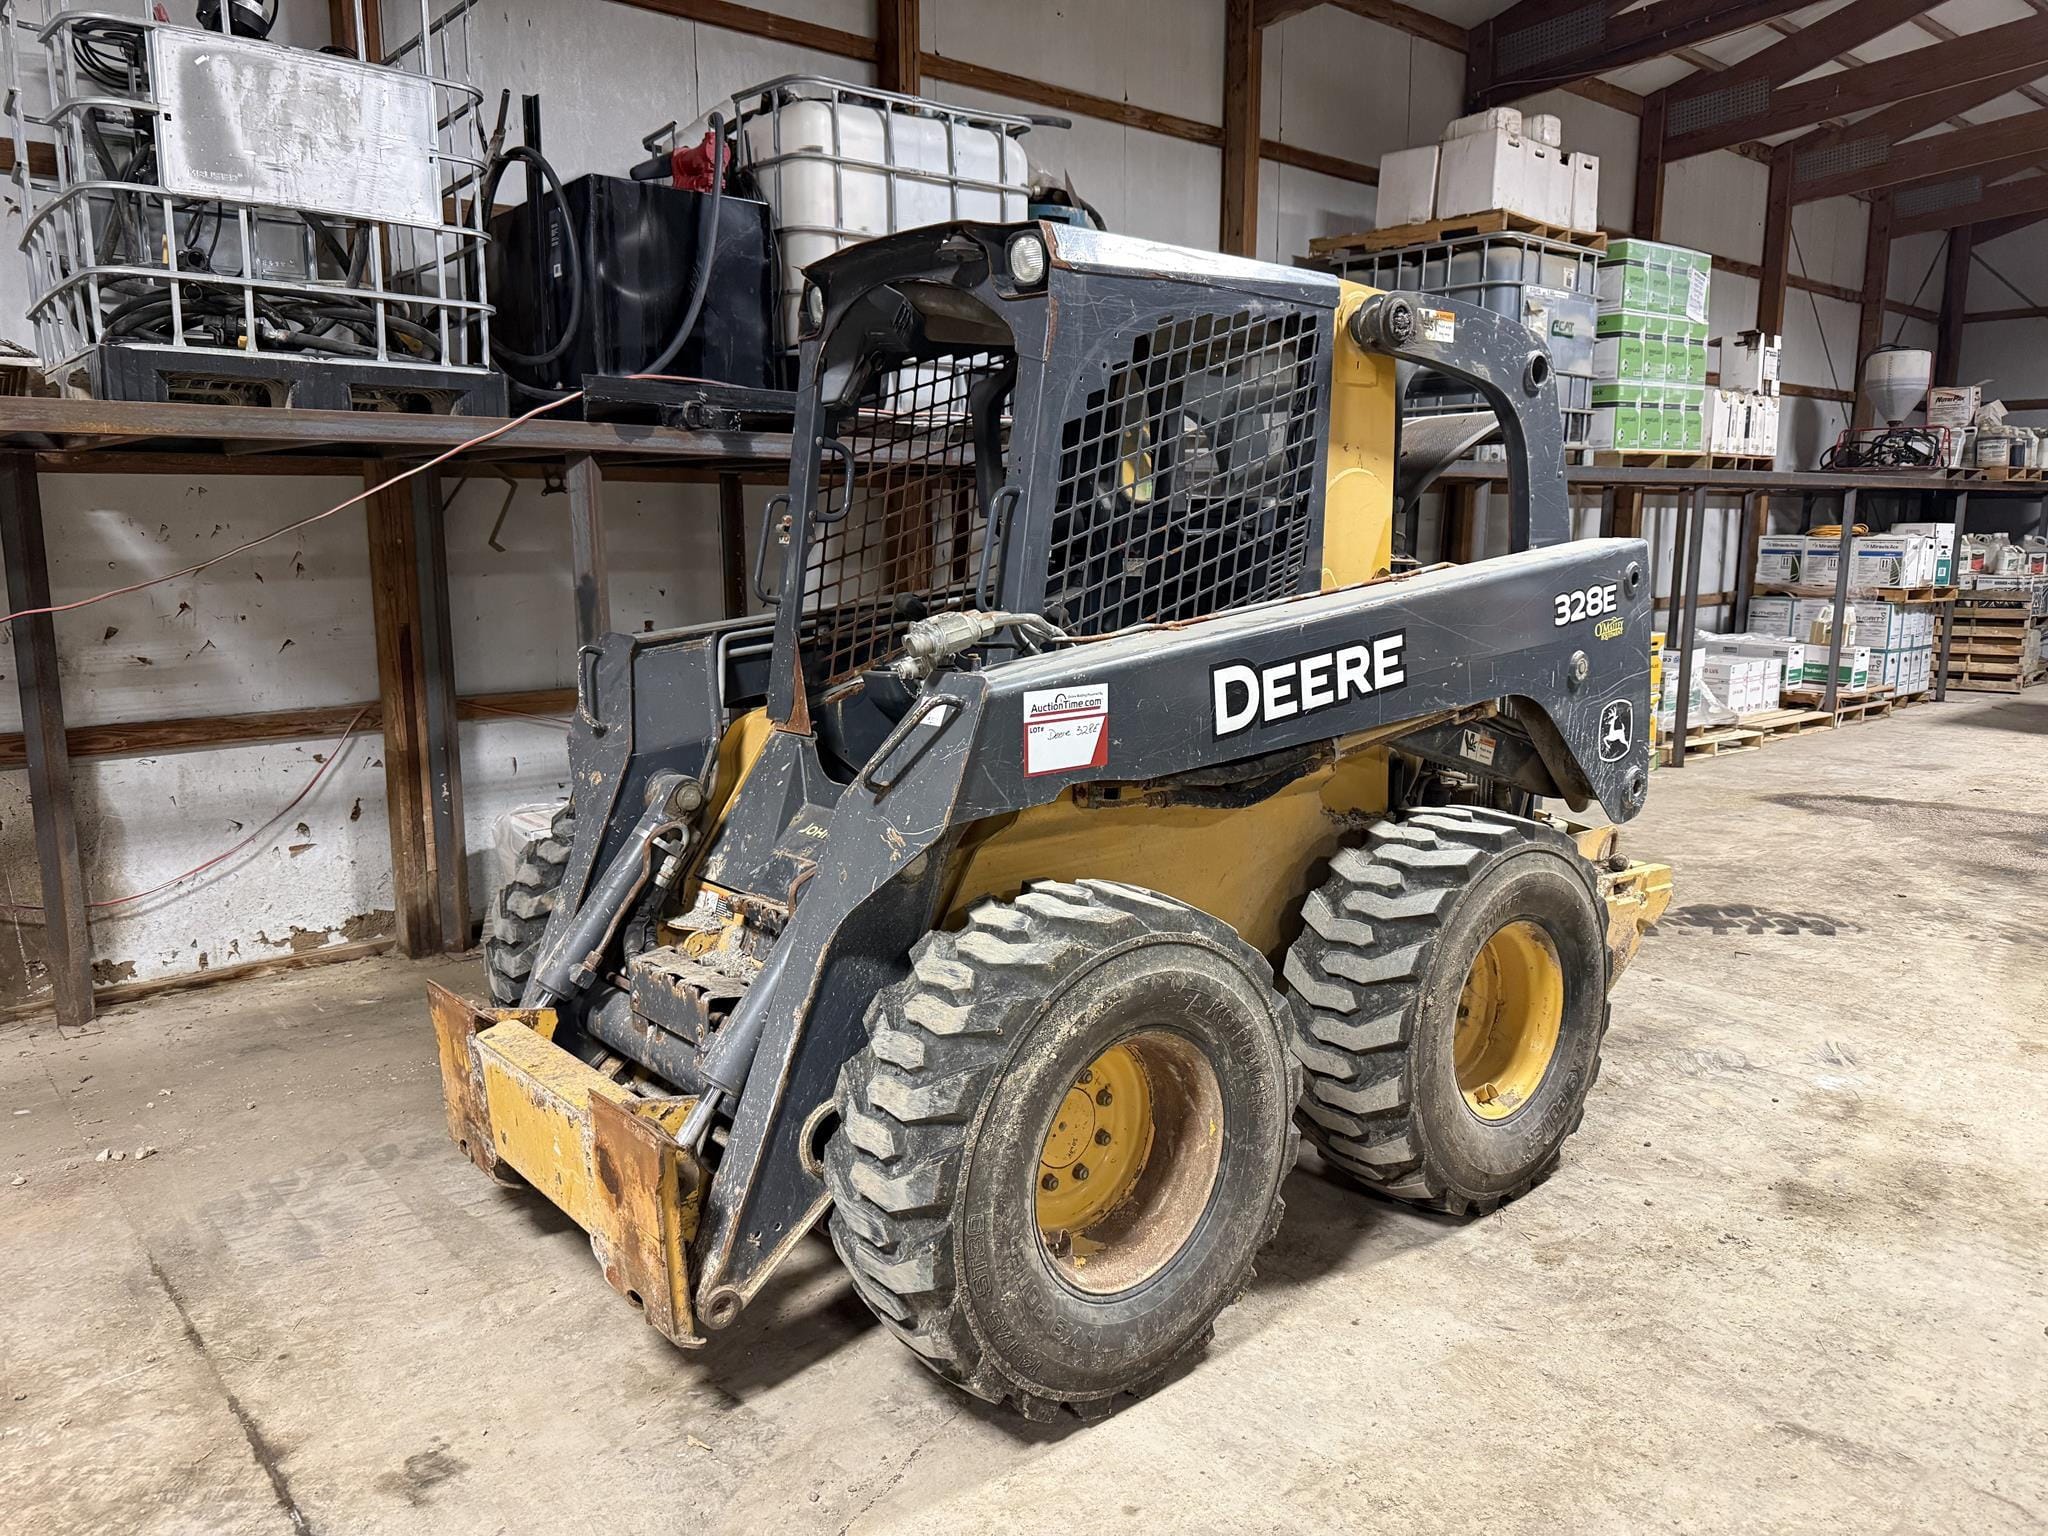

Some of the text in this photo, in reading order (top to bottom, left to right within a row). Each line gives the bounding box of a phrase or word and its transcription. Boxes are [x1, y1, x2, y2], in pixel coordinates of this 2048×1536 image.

[1555, 584, 1617, 626] 328E
[1213, 634, 1405, 736] DEERE
[1031, 698, 1102, 713] AuctionTime.com
[1029, 726, 1045, 734] LOT#
[797, 822, 829, 839] JOH
